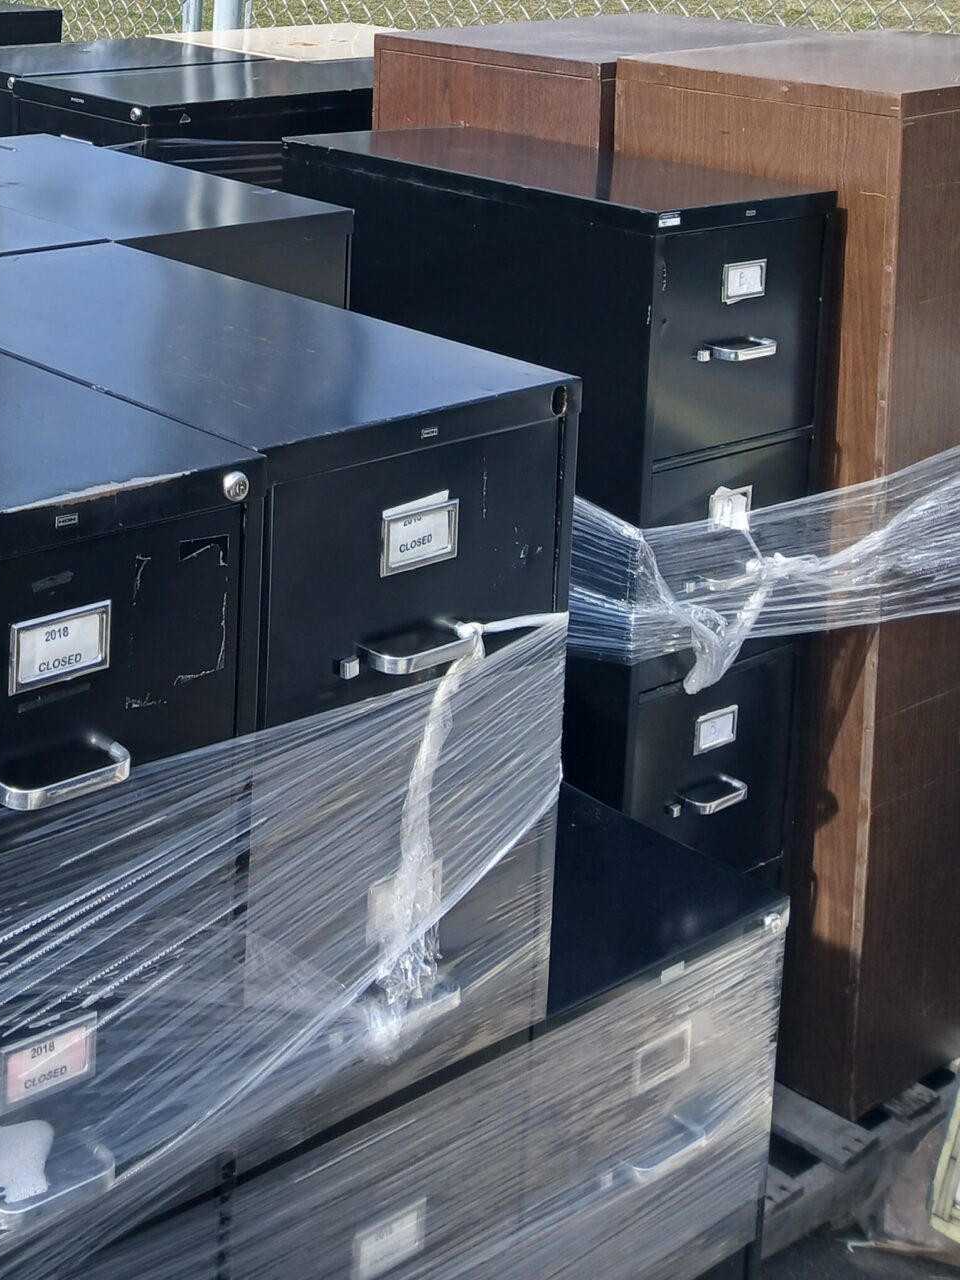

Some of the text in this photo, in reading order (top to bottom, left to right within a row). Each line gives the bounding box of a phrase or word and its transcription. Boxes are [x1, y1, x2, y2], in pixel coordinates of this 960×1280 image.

[399, 534, 433, 553] CLOSED
[44, 626, 69, 642] 2018
[38, 653, 82, 673] CLOSED
[31, 1041, 55, 1059] 2018
[24, 1065, 68, 1089] CLOSED
